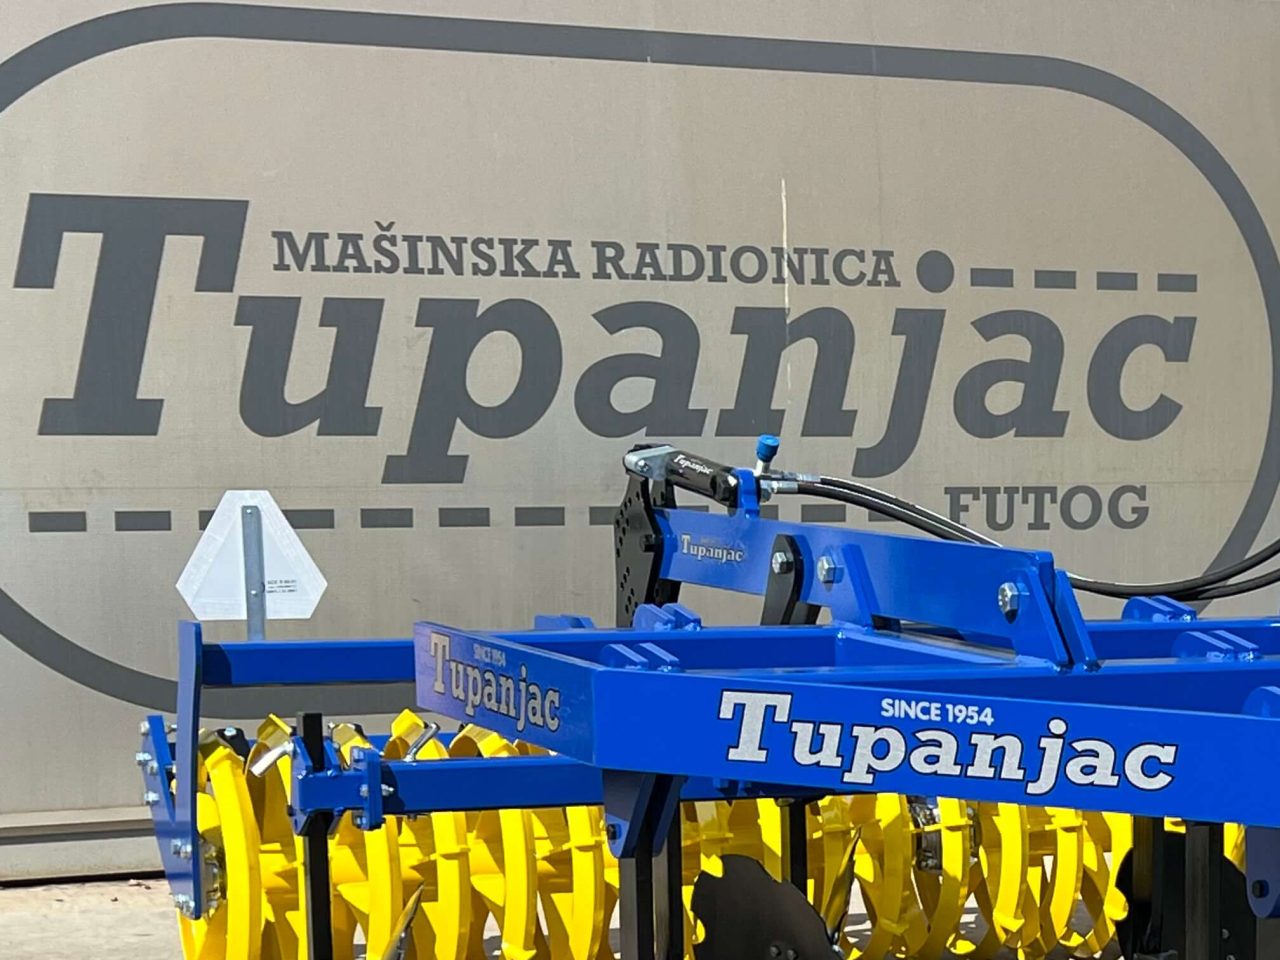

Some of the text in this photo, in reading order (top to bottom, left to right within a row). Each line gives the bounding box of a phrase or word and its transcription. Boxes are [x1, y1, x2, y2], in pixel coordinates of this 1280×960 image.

[271, 220, 901, 287] MAŠINSKA RADIONICA
[13, 192, 1197, 485] Tupanjac
[673, 453, 714, 475] Tupanjac
[944, 484, 1149, 531] FUTOG
[681, 534, 744, 563] Tupanjac
[430, 631, 560, 733] Tupanjac
[881, 698, 995, 726] SINCE 1954
[718, 689, 1178, 796] Tupanjac
